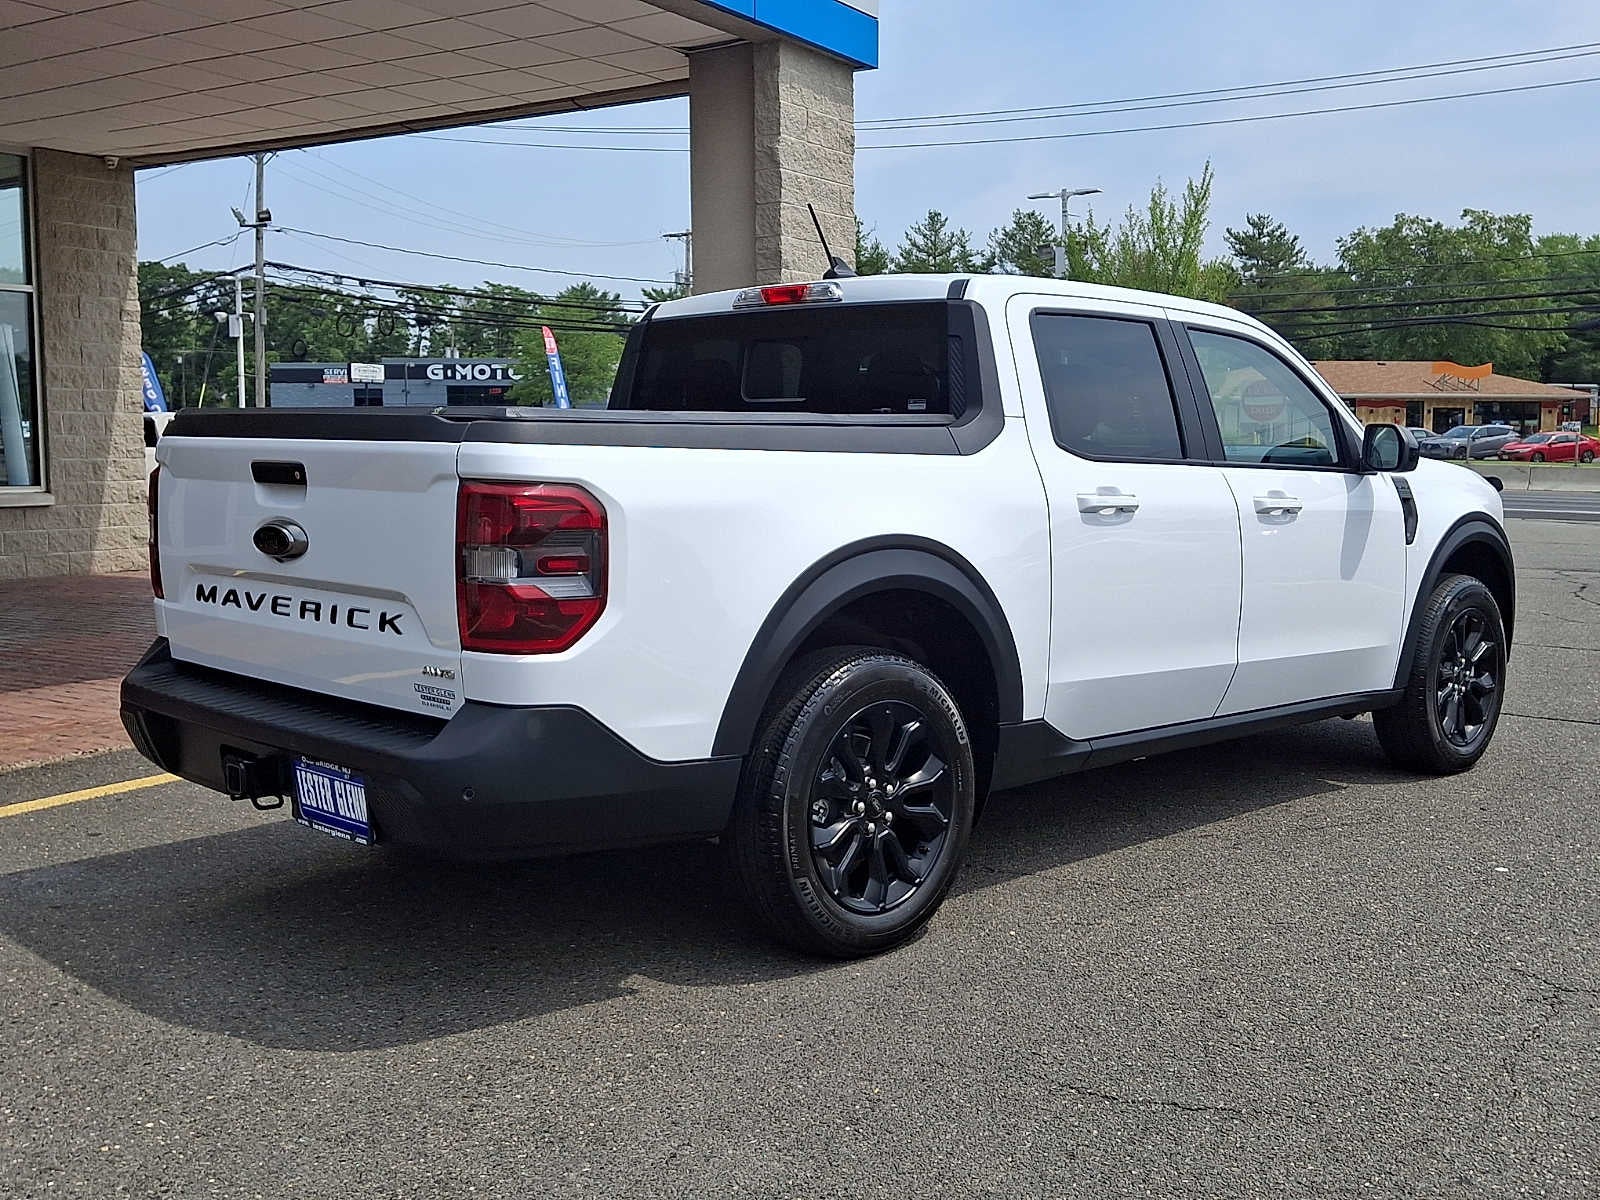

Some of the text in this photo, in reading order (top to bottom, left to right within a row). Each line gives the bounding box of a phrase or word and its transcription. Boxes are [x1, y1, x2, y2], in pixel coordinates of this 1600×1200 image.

[195, 583, 403, 636] MAVERICK
[928, 685, 967, 741] MICHELIN
[296, 769, 368, 823] LESTER GLENN
